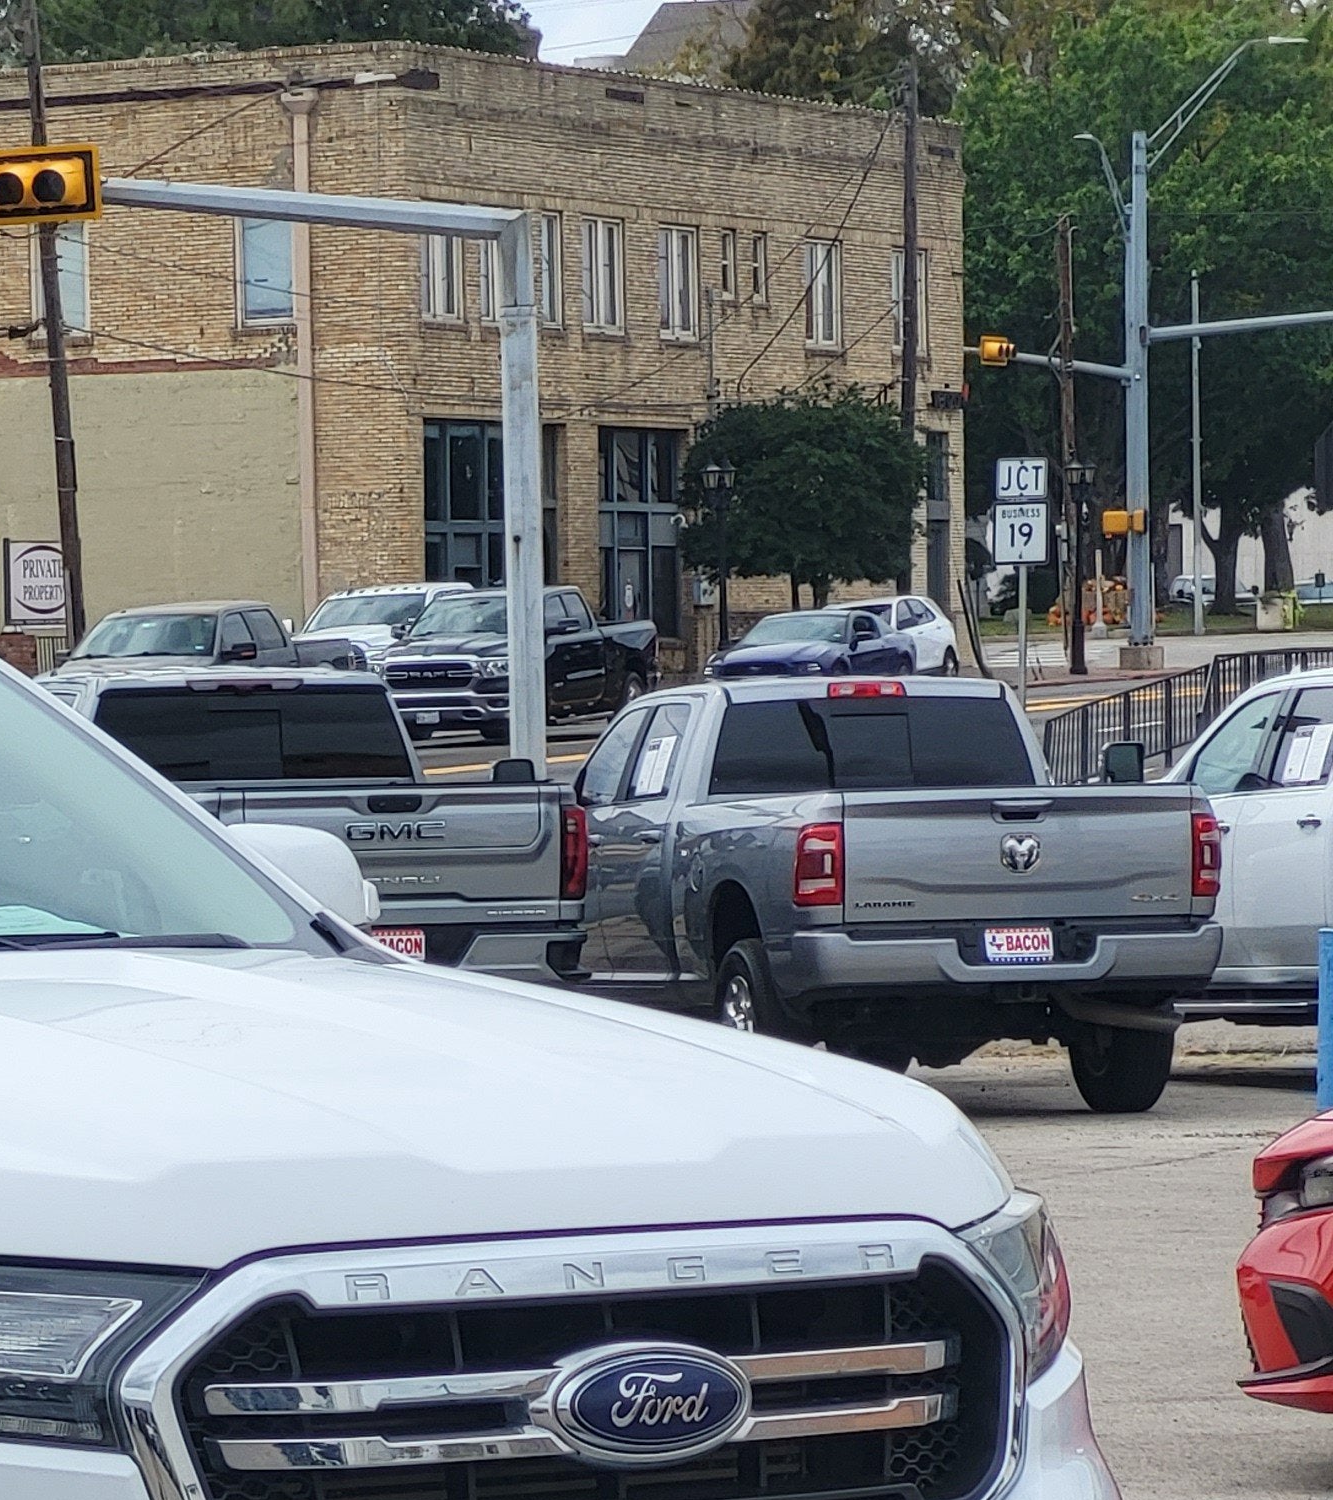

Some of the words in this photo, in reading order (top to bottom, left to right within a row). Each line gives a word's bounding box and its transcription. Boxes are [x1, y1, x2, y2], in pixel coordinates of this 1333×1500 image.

[1001, 466, 1043, 491] JCT
[1001, 508, 1041, 519] BUSINESS
[1009, 523, 1033, 548] 19
[23, 584, 63, 601] PROPERTY
[345, 820, 446, 841] GMC
[1006, 934, 1050, 951] BACON
[345, 1244, 895, 1301] RANGER
[610, 1371, 709, 1427] Ford
